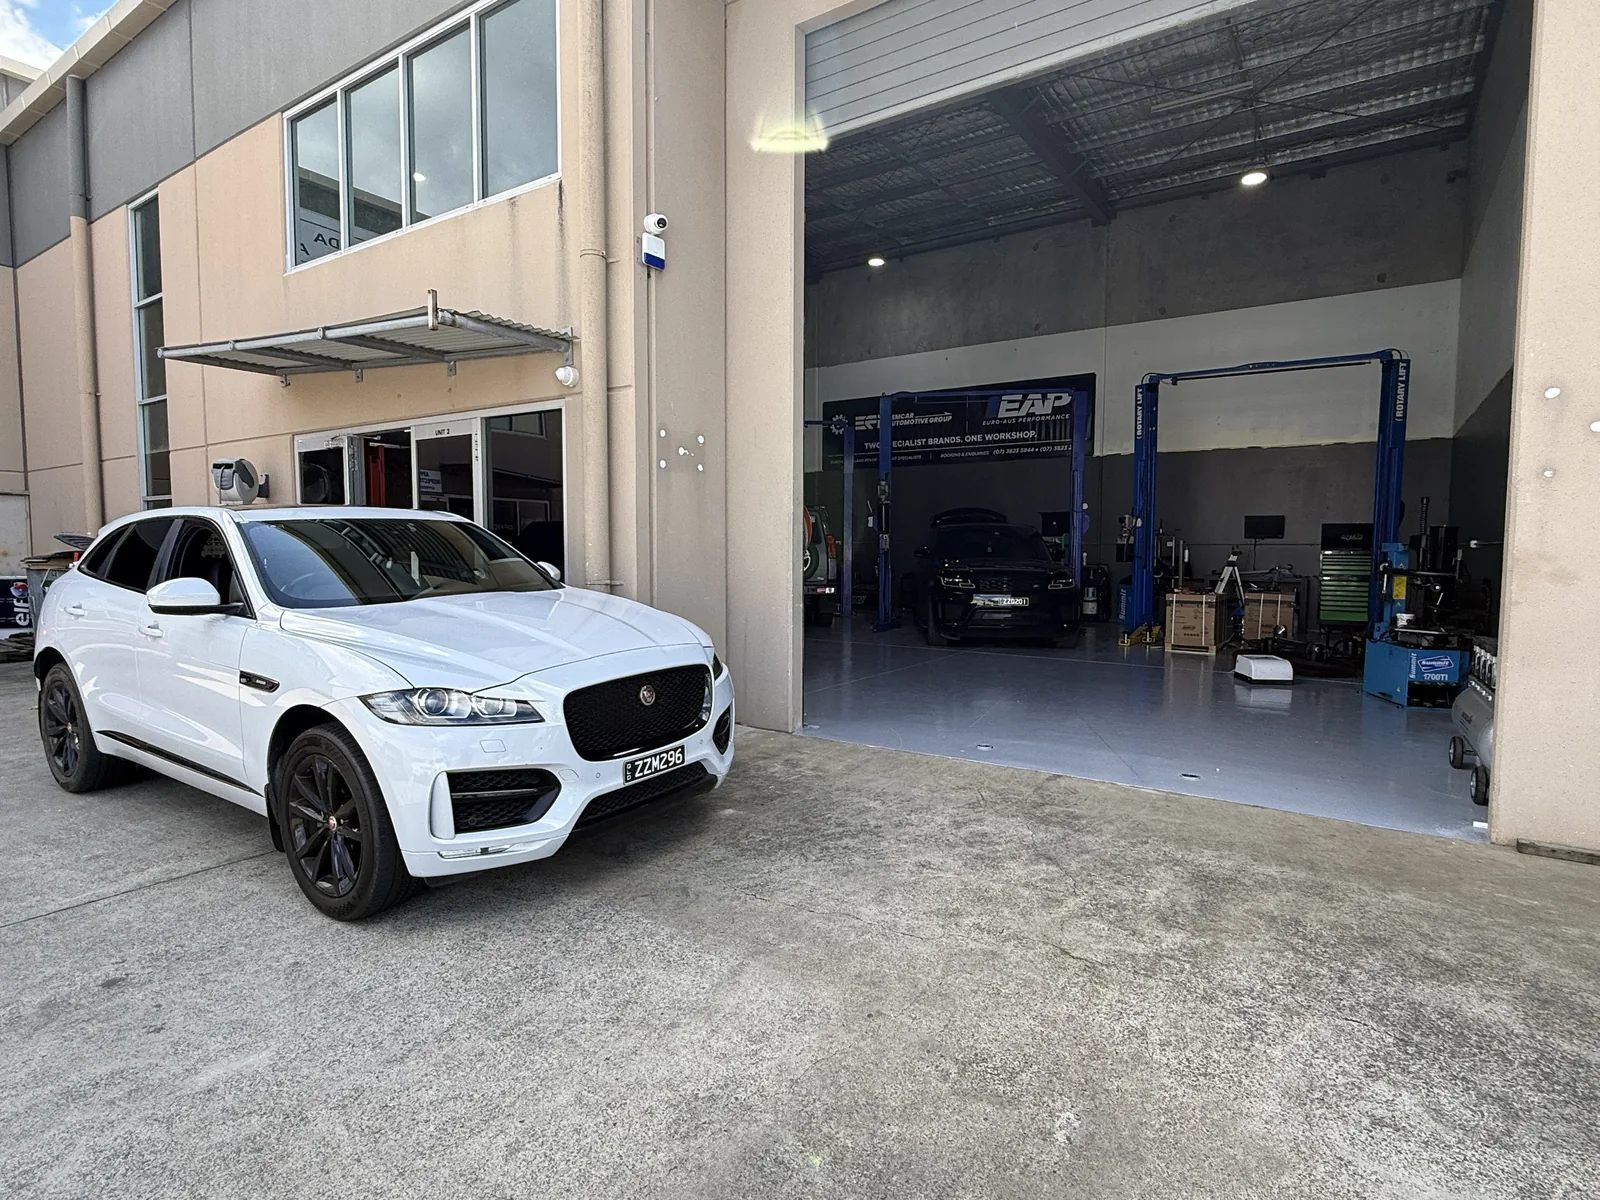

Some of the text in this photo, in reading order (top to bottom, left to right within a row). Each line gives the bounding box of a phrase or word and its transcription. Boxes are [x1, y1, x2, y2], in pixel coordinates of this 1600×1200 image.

[1395, 362, 1407, 417] ROTARY LIFT
[891, 415, 953, 427] UTOMOTIVE GROUP
[1018, 413, 1070, 423] PERFORMANCE
[434, 427, 451, 436] UNIT 2
[892, 438, 926, 448] ECIALIST
[927, 435, 963, 446] BRANDS.
[964, 434, 983, 443] ONE
[984, 431, 1038, 441] WORKSHOP.
[13, 596, 30, 627] elf
[1423, 673, 1448, 681] 1700TI
[634, 747, 683, 778] ZZM296
